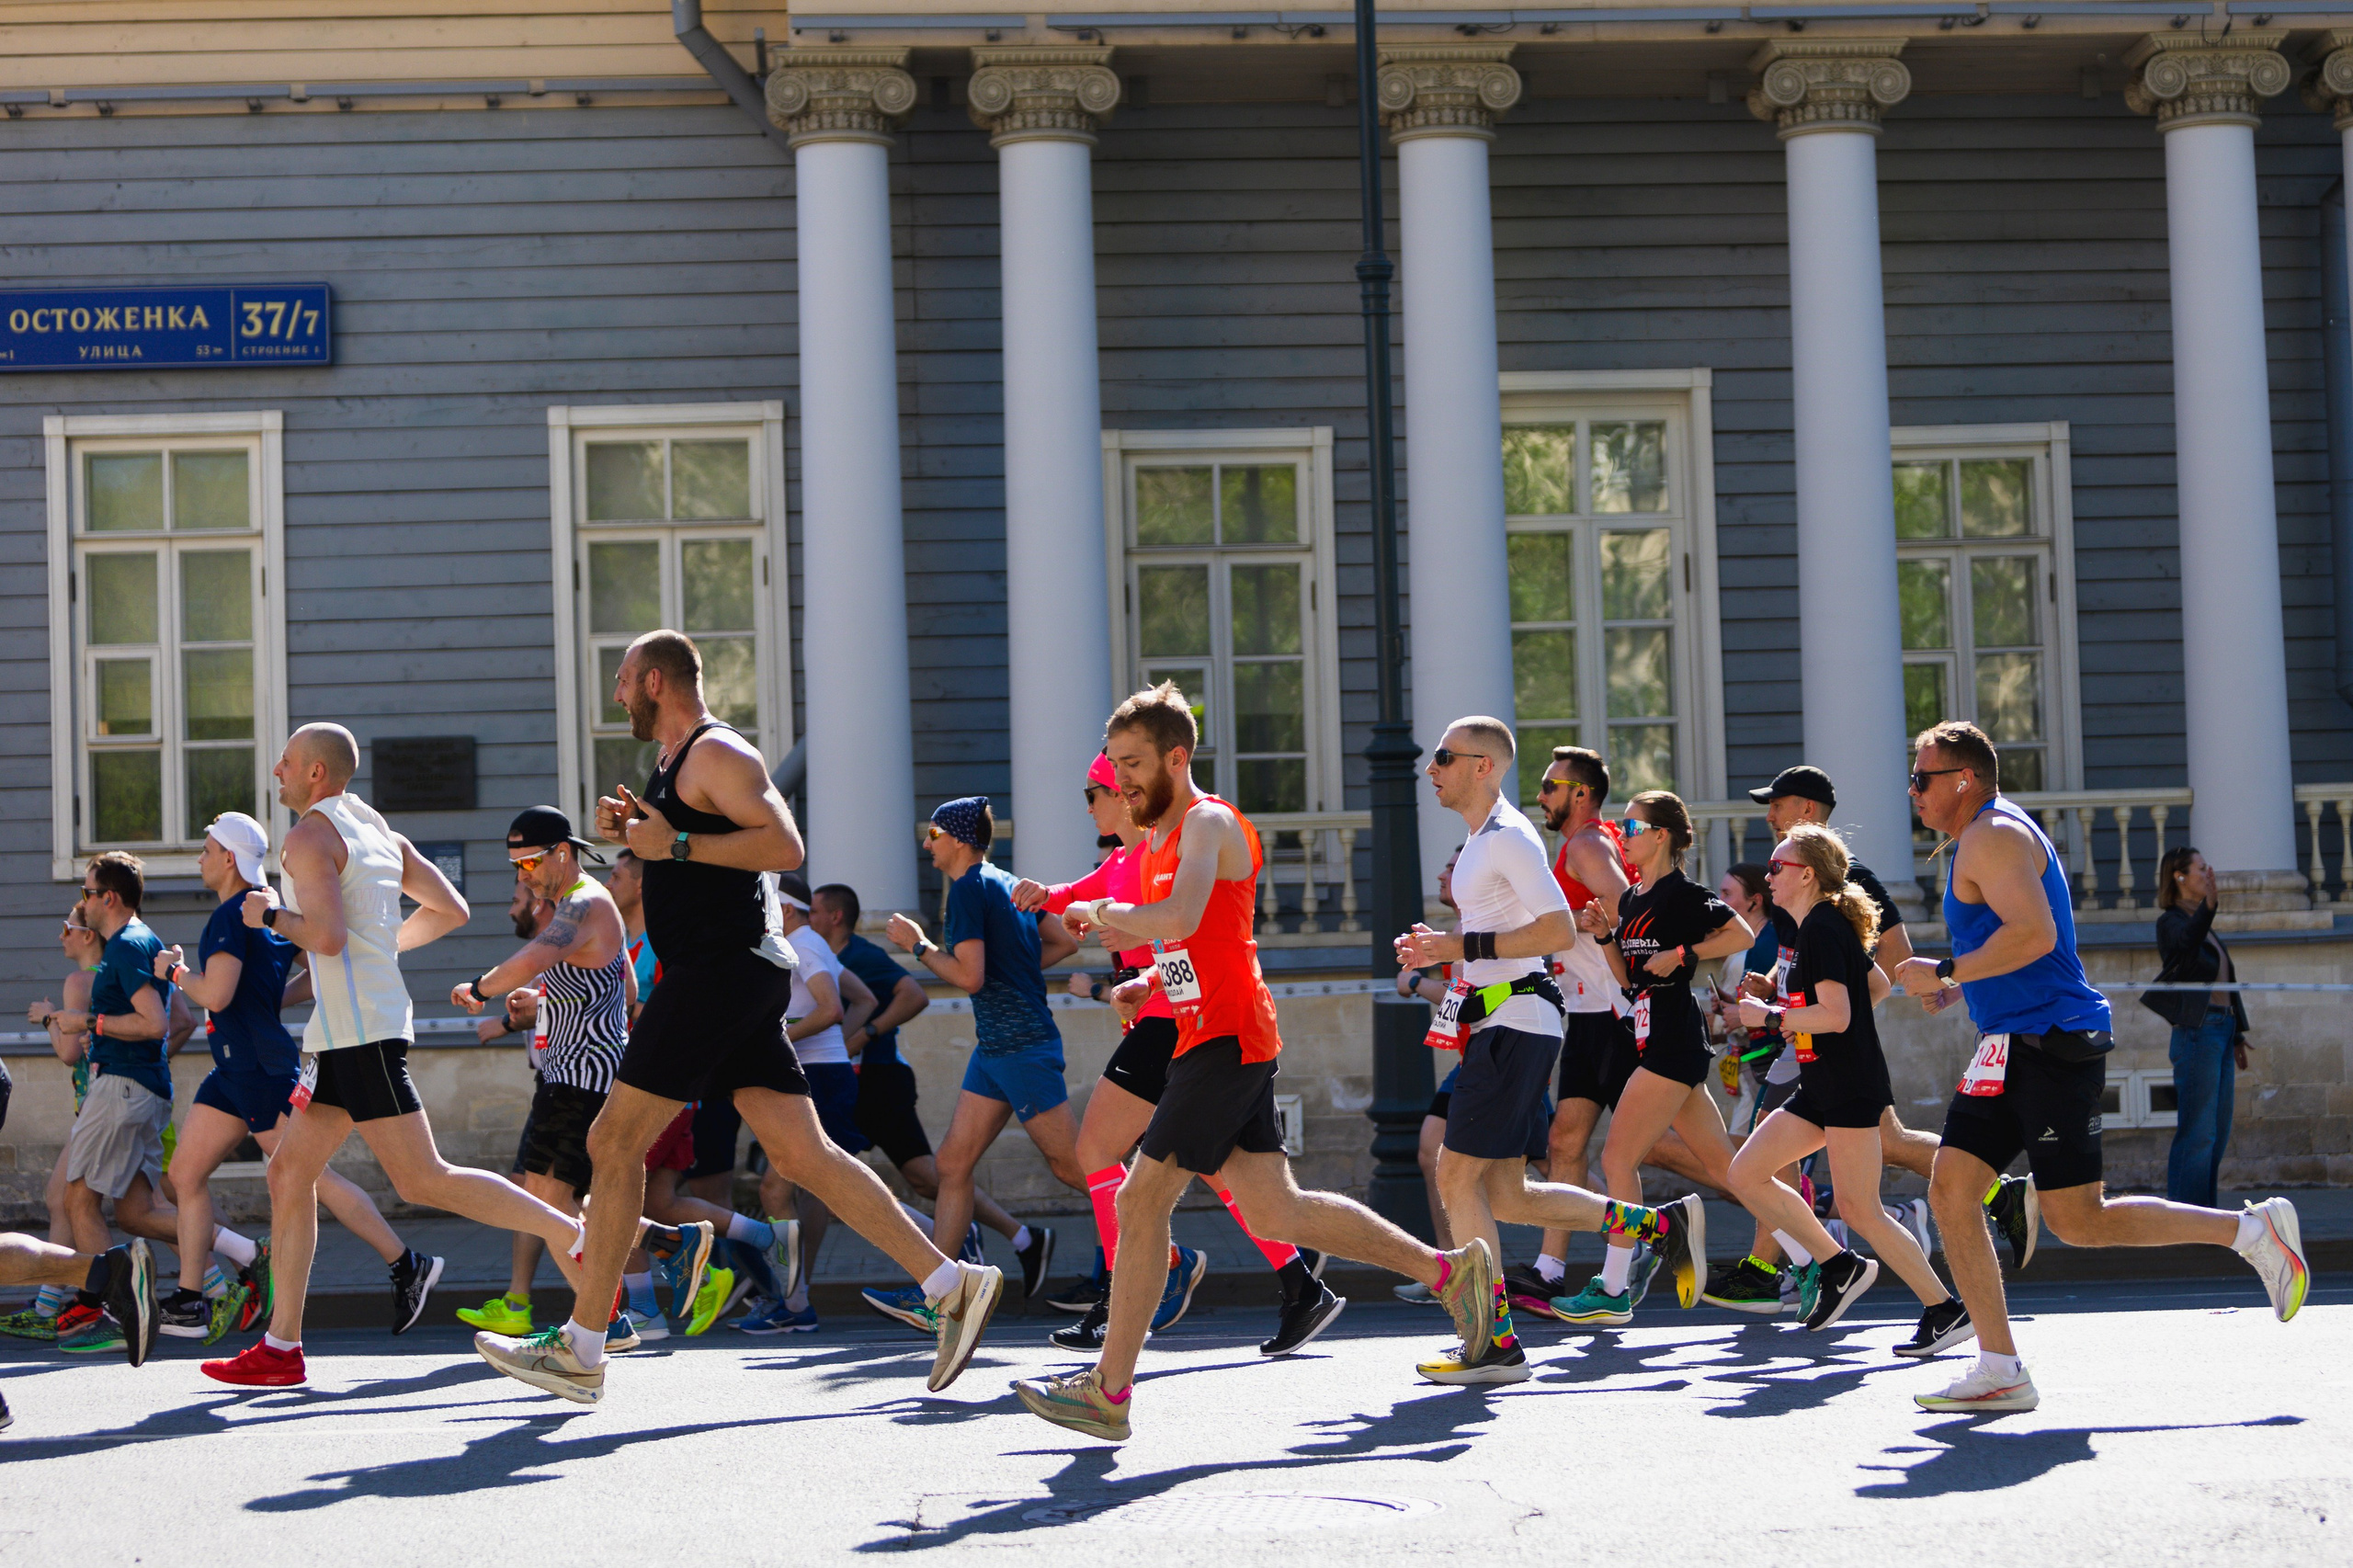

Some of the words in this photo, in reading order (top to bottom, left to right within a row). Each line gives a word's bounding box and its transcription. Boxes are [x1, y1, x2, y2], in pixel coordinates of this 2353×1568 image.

[9, 305, 210, 333] ОСТОЖЕНКА
[241, 300, 319, 340] 37/7
[78, 345, 143, 359] УЛИЦА
